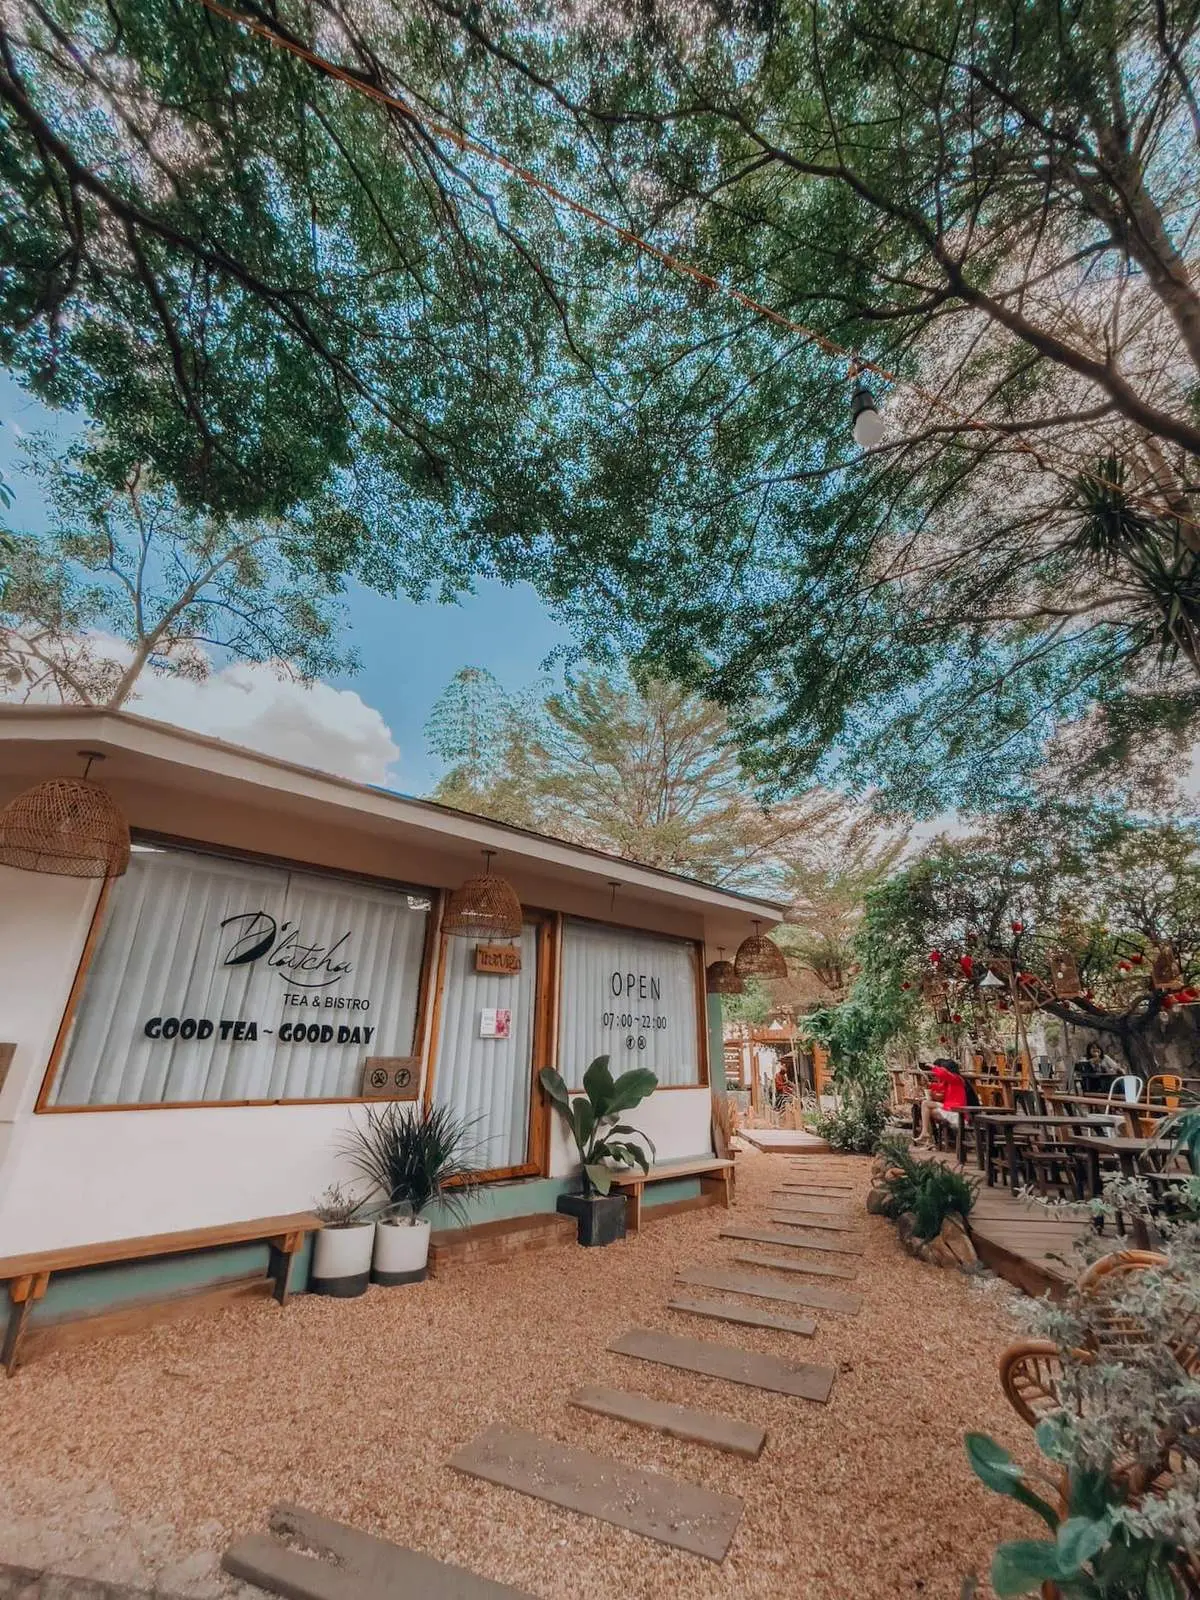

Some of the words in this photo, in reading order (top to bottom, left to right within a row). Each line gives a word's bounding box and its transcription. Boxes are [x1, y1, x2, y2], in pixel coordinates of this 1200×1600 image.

[611, 971, 661, 1001] OPEN
[283, 993, 308, 1007] TEA
[312, 995, 321, 1008] &
[324, 996, 370, 1011] BISTRO
[144, 1017, 214, 1041] GOOD
[219, 1020, 258, 1042] TEA
[278, 1022, 334, 1044] GOOD
[337, 1025, 375, 1045] DAY
